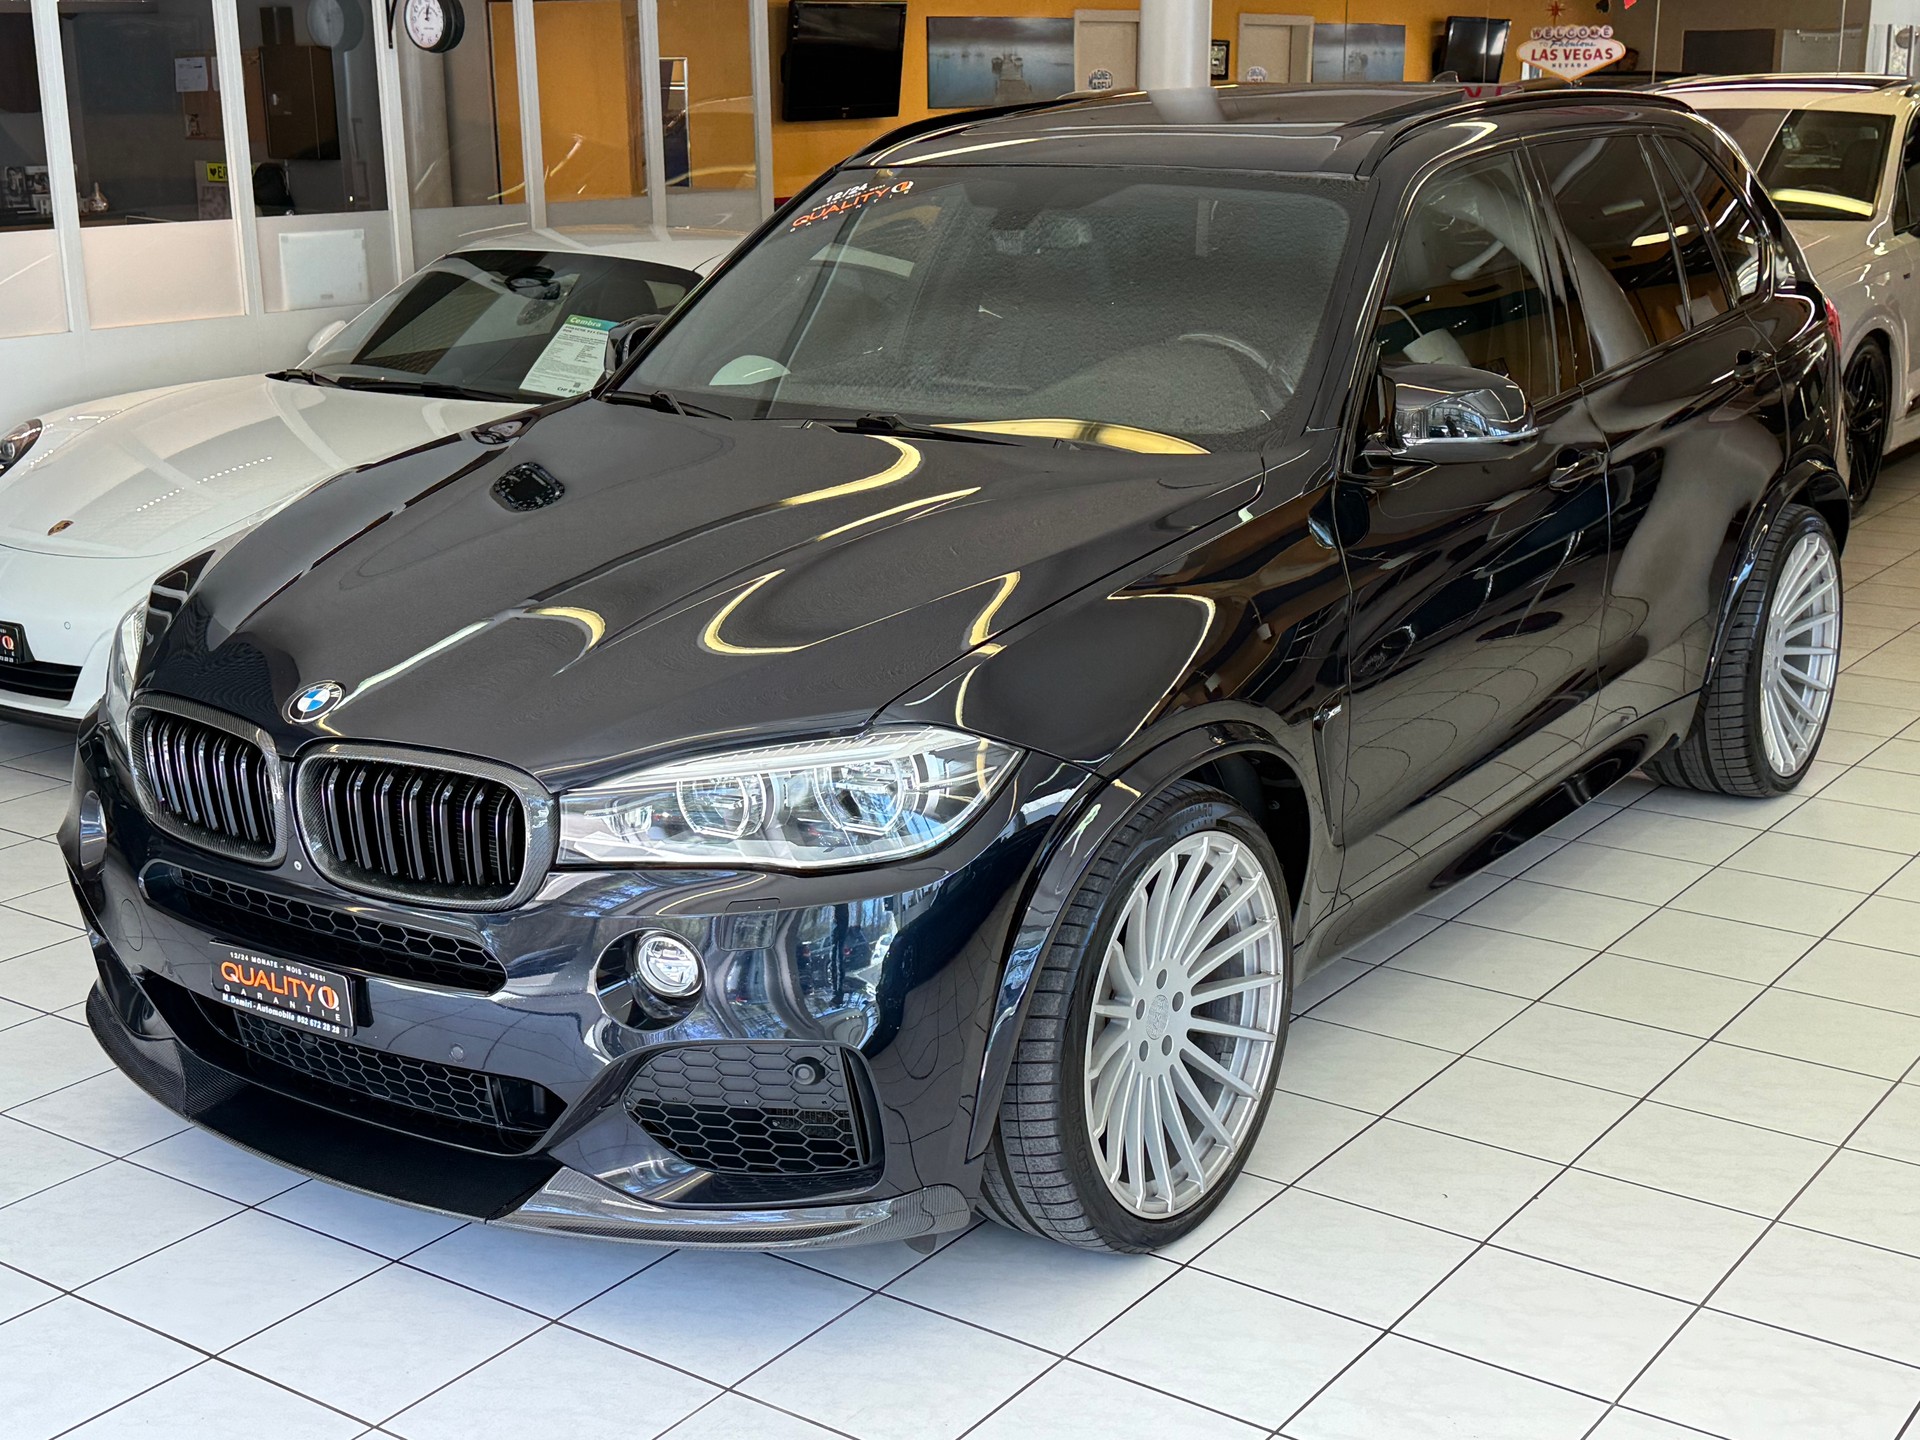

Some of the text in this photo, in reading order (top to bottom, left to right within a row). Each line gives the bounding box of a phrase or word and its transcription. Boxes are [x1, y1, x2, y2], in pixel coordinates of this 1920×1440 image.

[1532, 25, 1613, 38] WELCOME
[1531, 47, 1613, 61] LAS VEGAS
[826, 182, 869, 202] 12/24
[792, 186, 892, 227] QUALITY
[570, 317, 602, 328] Cembra
[229, 951, 249, 962] 12/24
[251, 956, 278, 969] MONATE
[286, 965, 302, 976] MOIS
[220, 961, 316, 1002] QUALITY
[224, 983, 341, 1022] GARANTIE
[256, 1003, 295, 1021] Automobile
